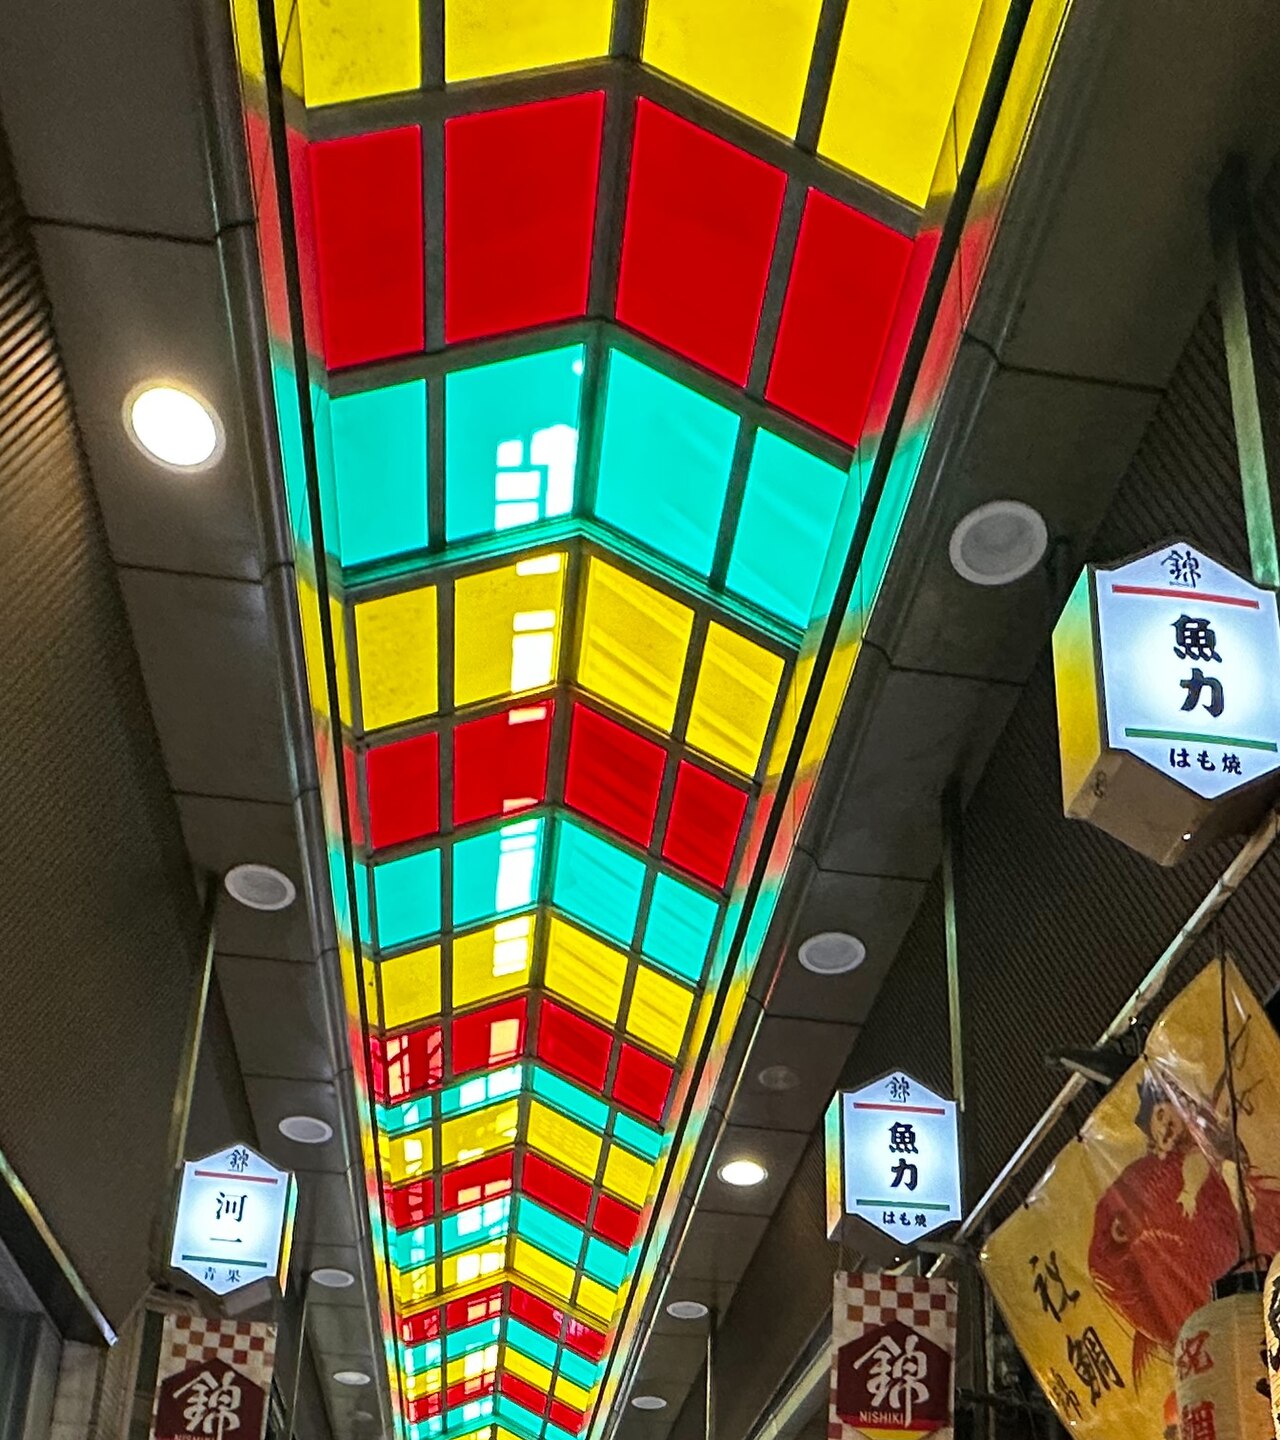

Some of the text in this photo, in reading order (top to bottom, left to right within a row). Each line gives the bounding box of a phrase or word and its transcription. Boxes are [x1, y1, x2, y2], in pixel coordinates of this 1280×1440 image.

[1161, 550, 1201, 588] 錦
[1171, 613, 1225, 719] 魚力
[1169, 748, 1242, 775] はも焼
[888, 1121, 919, 1192] 魚力
[210, 1191, 248, 1243] 河一
[882, 1211, 927, 1228] はも焼
[204, 1266, 241, 1283] 青果
[852, 1334, 930, 1429] 錦
[859, 1411, 905, 1426] NISHIKI
